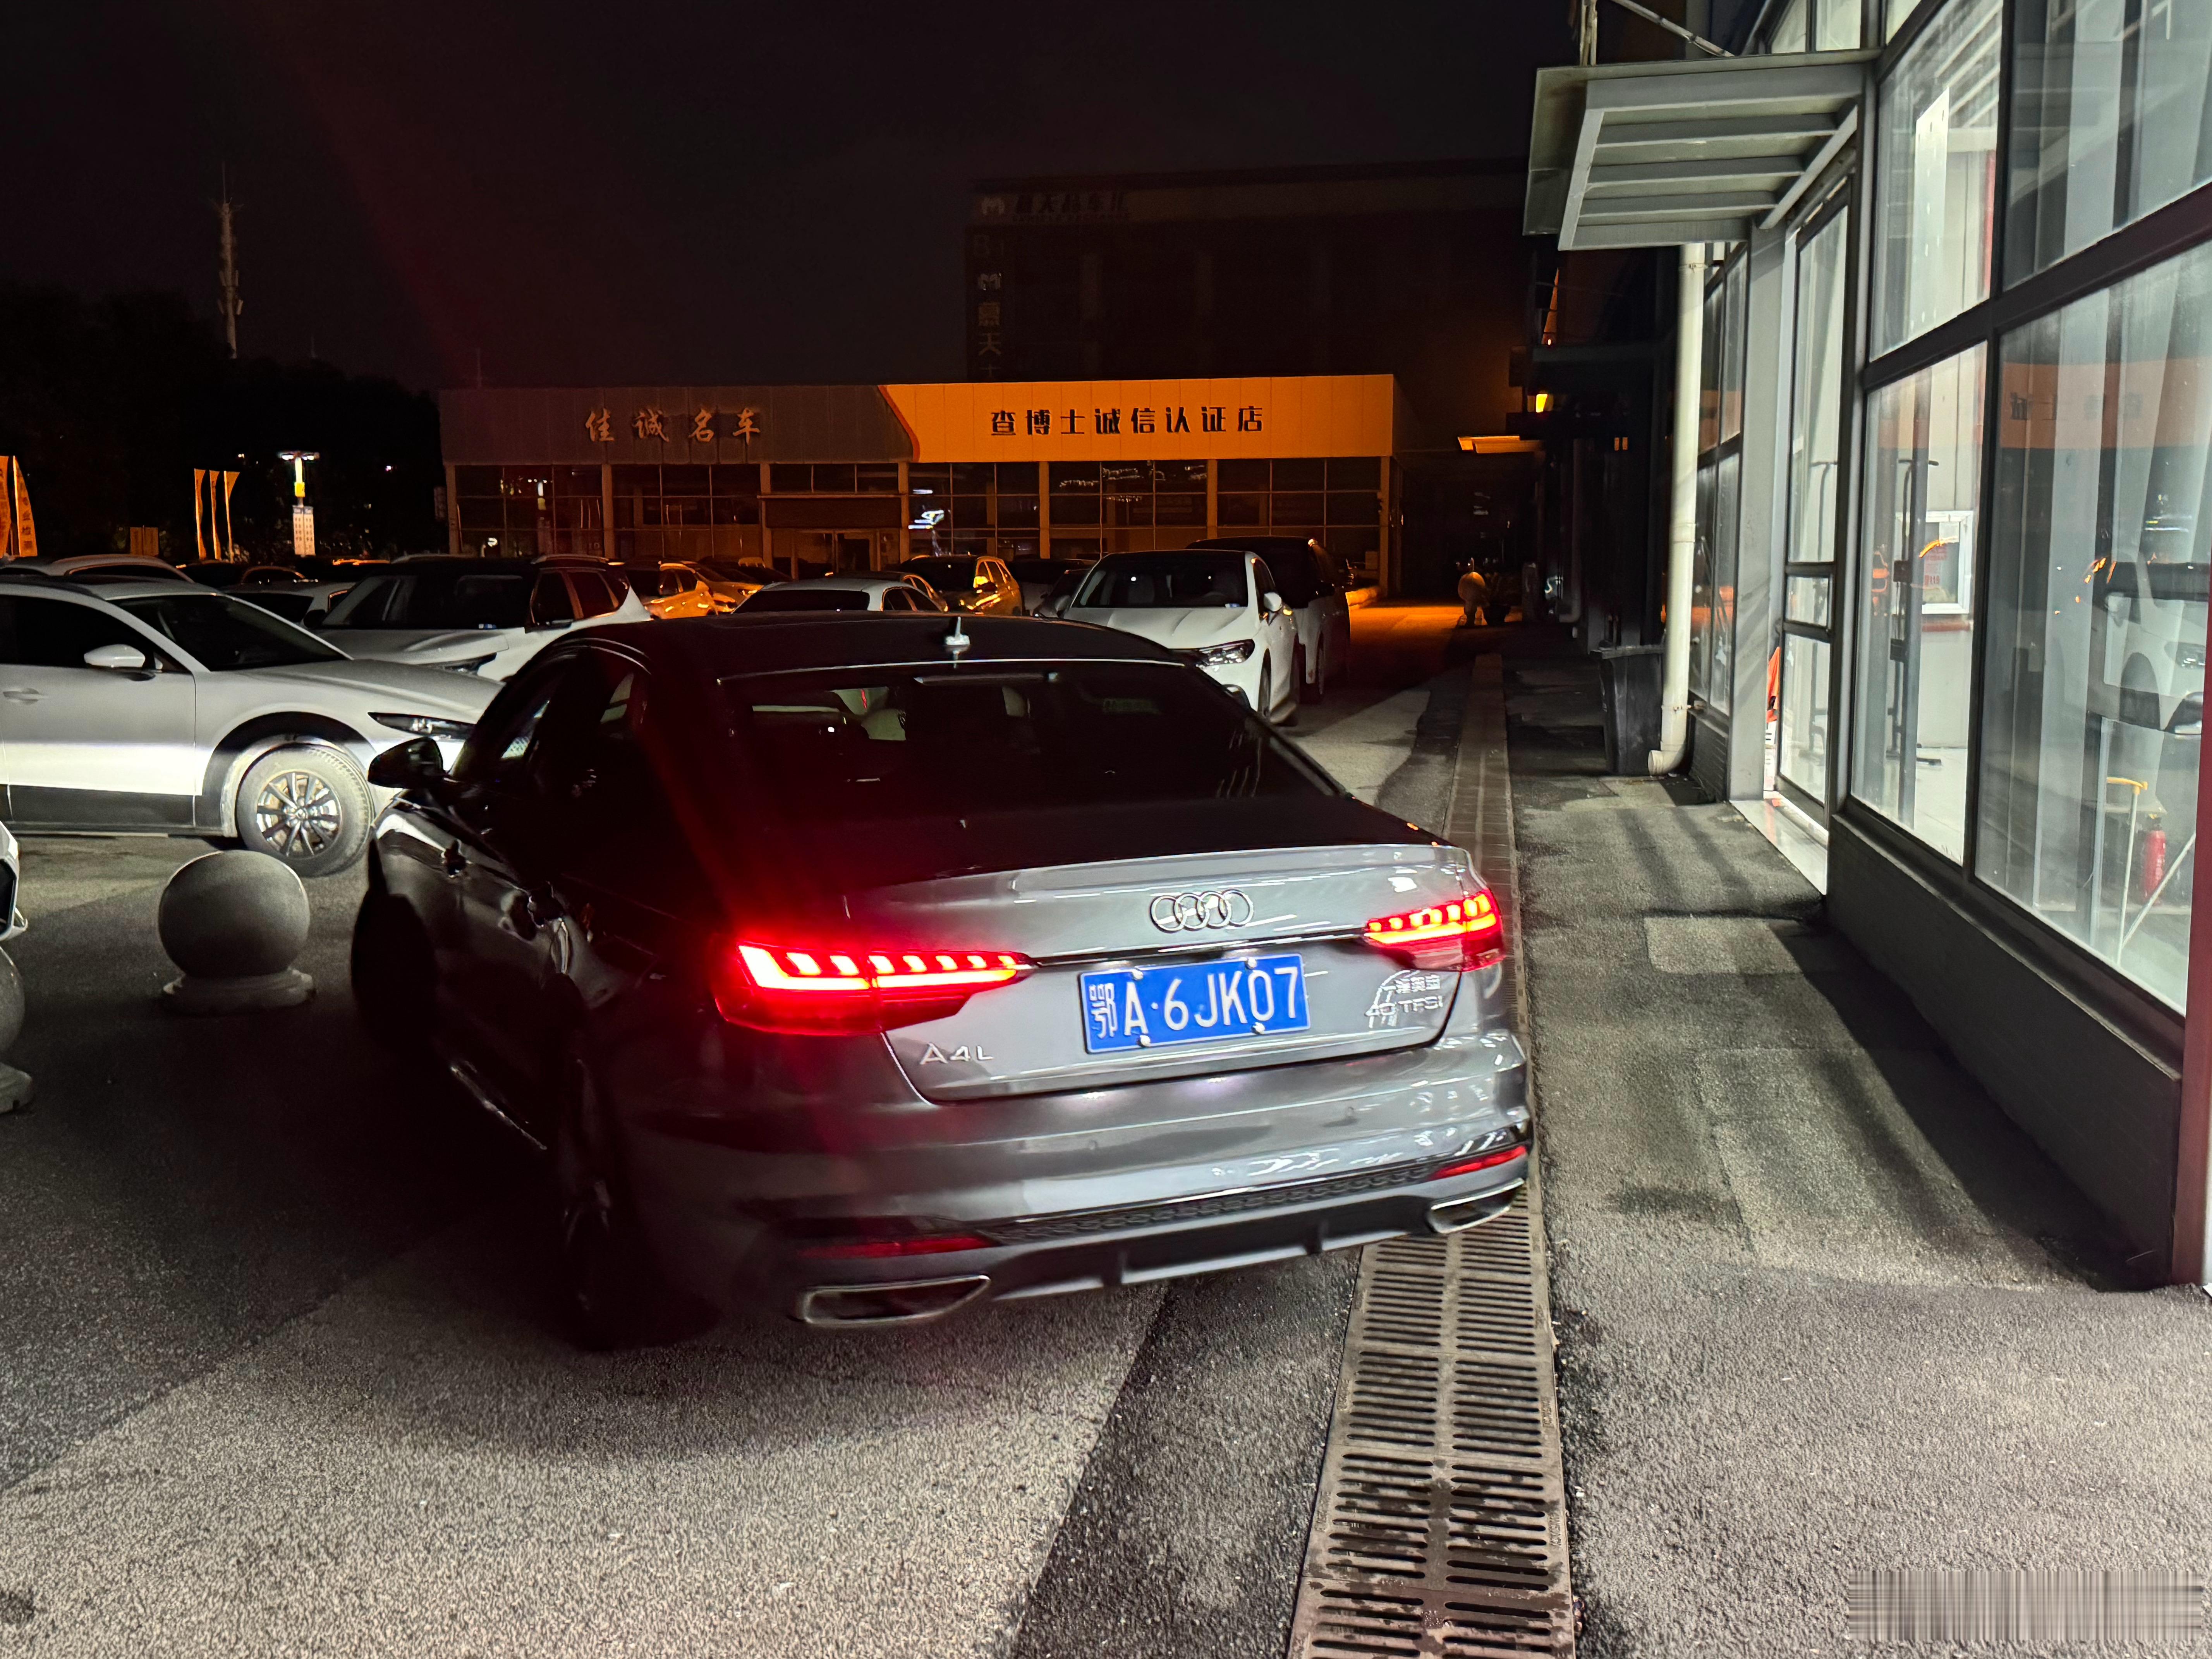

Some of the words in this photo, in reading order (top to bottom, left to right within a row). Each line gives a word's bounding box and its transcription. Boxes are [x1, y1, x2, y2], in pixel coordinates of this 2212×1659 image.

[585, 407, 761, 444] 佳诚名车
[991, 405, 1263, 436] 查博士诚信认证店
[919, 1042, 994, 1065] A4L
